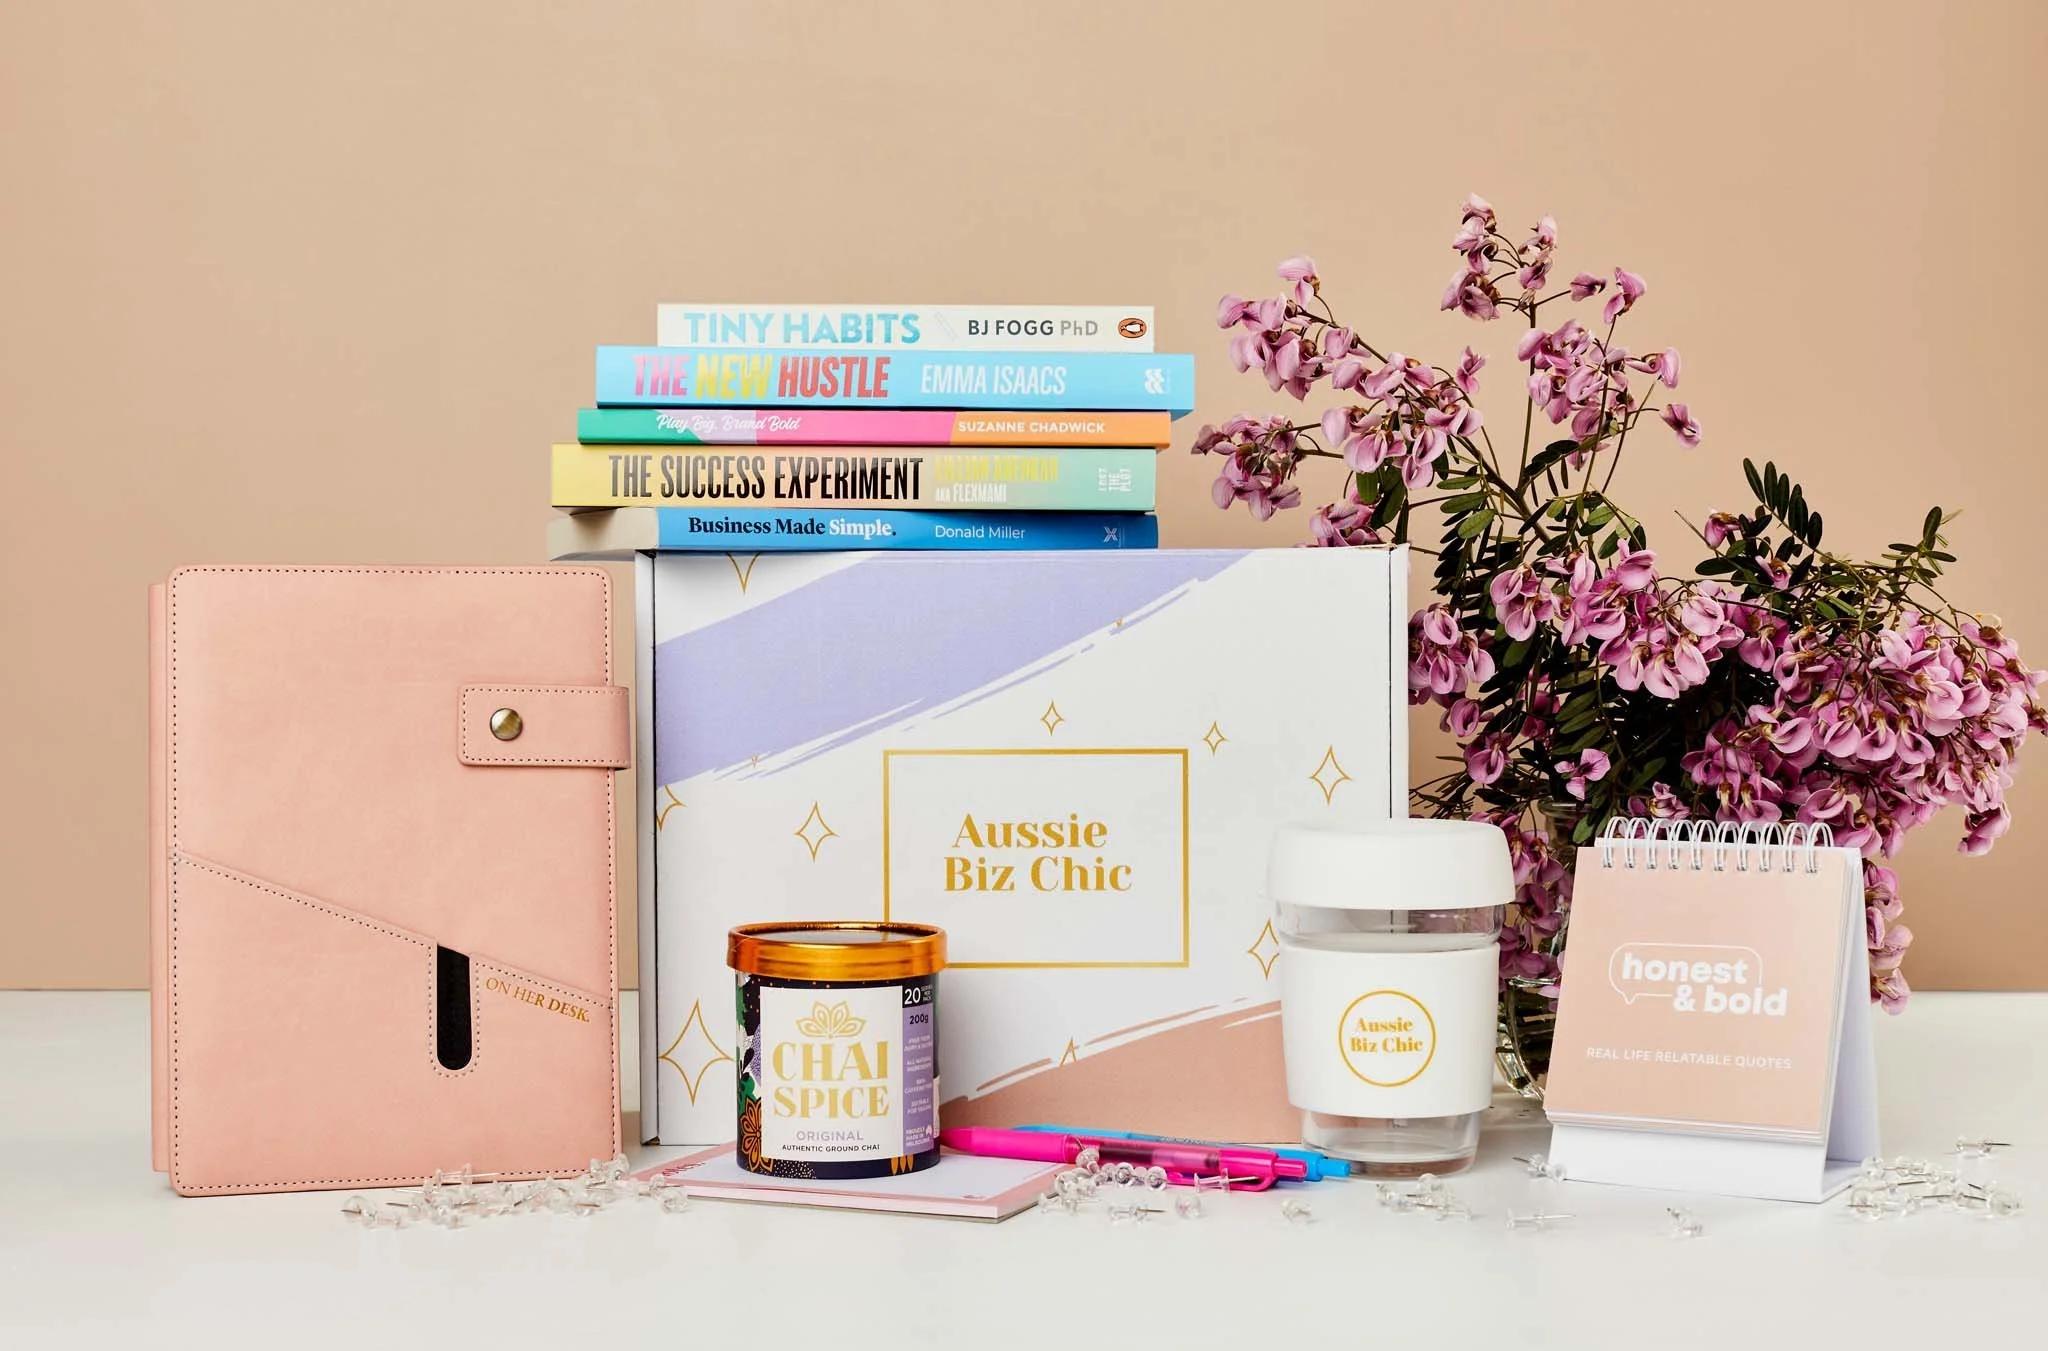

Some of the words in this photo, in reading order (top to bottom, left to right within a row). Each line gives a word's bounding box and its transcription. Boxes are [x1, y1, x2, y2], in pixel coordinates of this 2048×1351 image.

[684, 312, 774, 343] TINY
[783, 313, 920, 344] HABITS
[968, 320, 989, 336] BJ
[996, 320, 1054, 336] FOGG
[1060, 320, 1098, 336] PhD
[633, 355, 690, 396] THE
[695, 354, 773, 398] NEW
[778, 356, 891, 398] HUSTLE
[921, 364, 987, 394] EMMA
[993, 364, 1067, 395] ISAACS
[656, 414, 688, 434] Play
[720, 414, 766, 432] Brand
[768, 415, 801, 432] Bold
[958, 421, 1025, 433] SUZANNE
[1029, 421, 1105, 434] CHADWICK
[609, 454, 652, 497] THE
[660, 455, 765, 499] SUCCESS
[774, 456, 923, 500] EXPERIMENT
[1108, 472, 1120, 492] THE
[935, 487, 950, 503] AKA
[953, 482, 1007, 503] FLEXMAMI
[688, 516, 771, 535] Business
[775, 517, 826, 535] Made
[829, 518, 897, 540] Simple.
[935, 525, 984, 539] Donald
[988, 526, 1026, 540] Miller
[952, 813, 1108, 848] Aussie
[944, 856, 1015, 892] Biz
[1030, 855, 1132, 892] Chic
[1622, 953, 1748, 985] honest
[486, 977, 511, 995] ON
[513, 986, 544, 1008] HER
[547, 998, 590, 1023] DESK.
[904, 987, 921, 1005] 20
[1673, 984, 1696, 1012] &
[1703, 985, 1788, 1016] bold
[909, 1013, 929, 1025] 200g
[1354, 1016, 1413, 1033] Aussie
[1350, 1037, 1378, 1053] Biz
[1382, 1036, 1423, 1053] Chic
[772, 1041, 889, 1082] CHAI
[1586, 1047, 1619, 1060] REAL
[1624, 1049, 1651, 1061] LIFE
[1655, 1051, 1731, 1066] RELATABLE
[1735, 1055, 1793, 1070] QUOTES
[773, 1086, 890, 1120] SPICE
[781, 1144, 823, 1152] AUTHENTIC
[861, 1143, 880, 1151] CHAI
[796, 1130, 864, 1142] ORIGINAL
